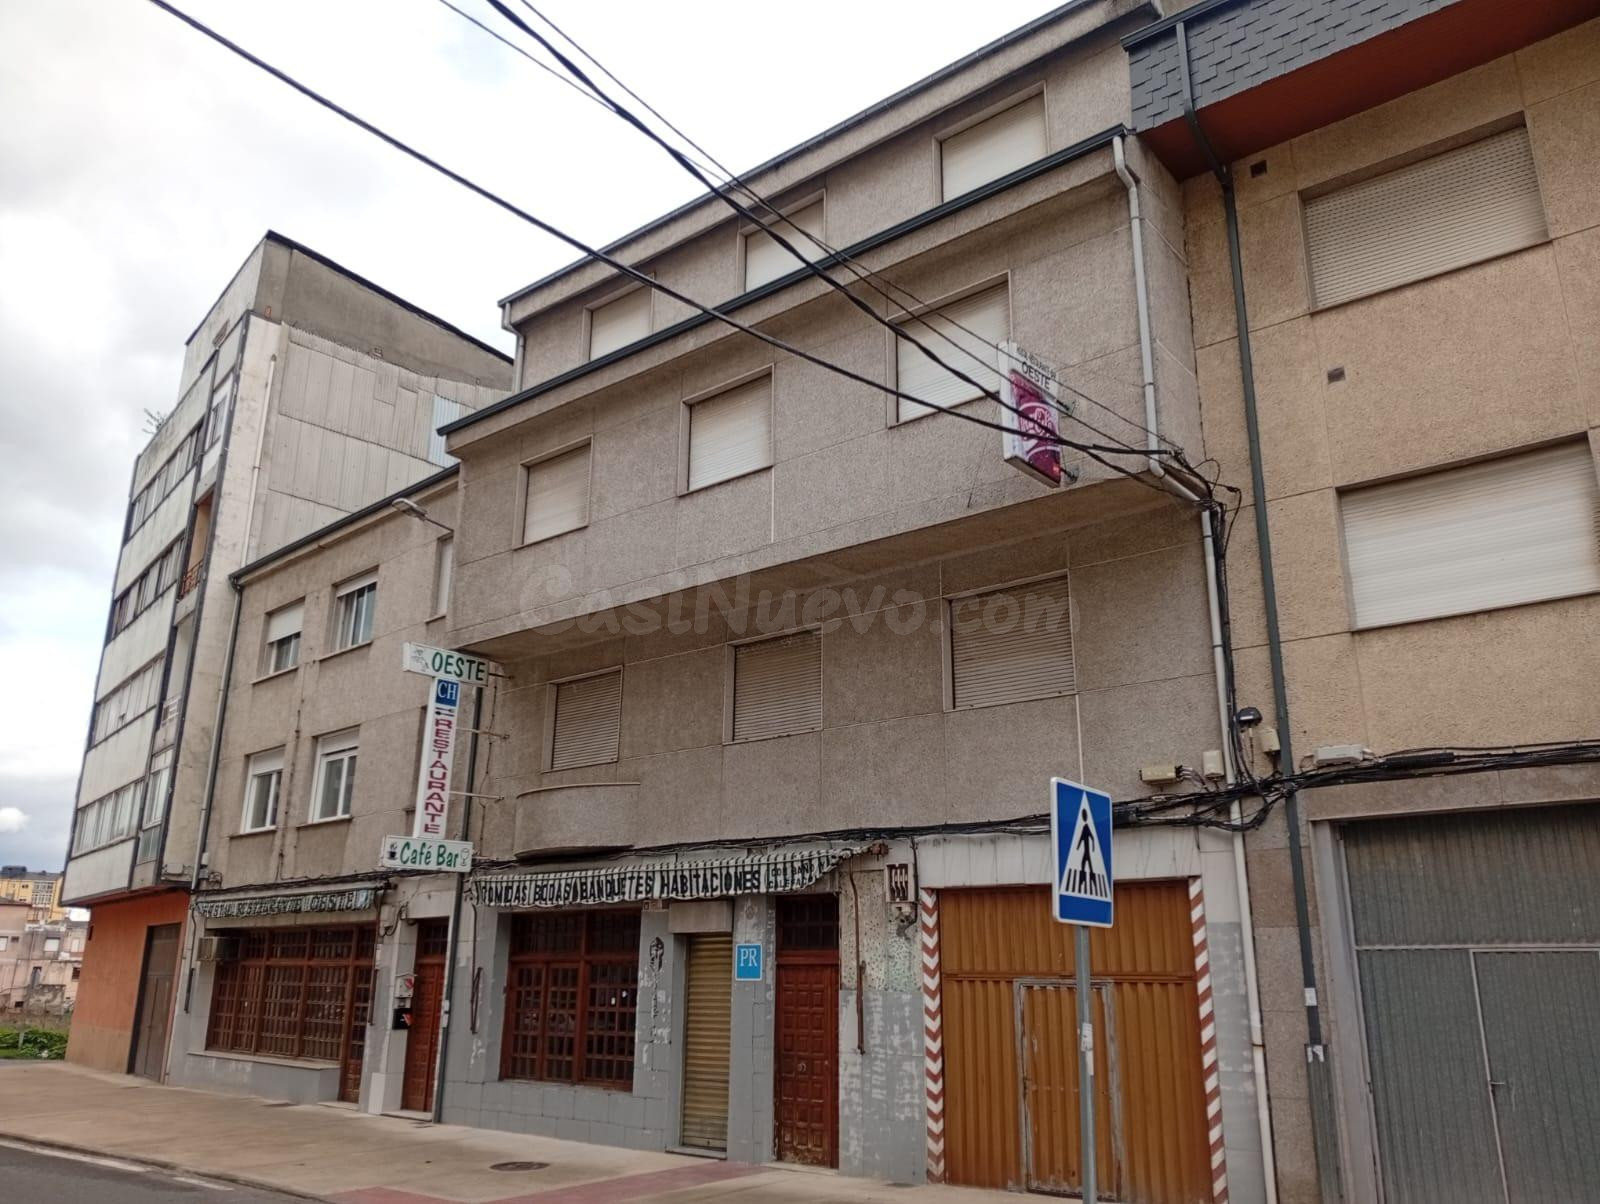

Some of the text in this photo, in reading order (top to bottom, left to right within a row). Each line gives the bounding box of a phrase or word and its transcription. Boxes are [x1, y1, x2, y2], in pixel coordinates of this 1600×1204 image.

[1022, 361, 1050, 391] OESTE
[432, 652, 486, 681] OESTE
[437, 681, 458, 700] CH
[424, 719, 453, 834] RESTAURANTE
[400, 842, 459, 868] Café Bar
[482, 870, 761, 901] COMIDAS BODAS BANQUETES HABITACIONES
[740, 948, 757, 967] PR
